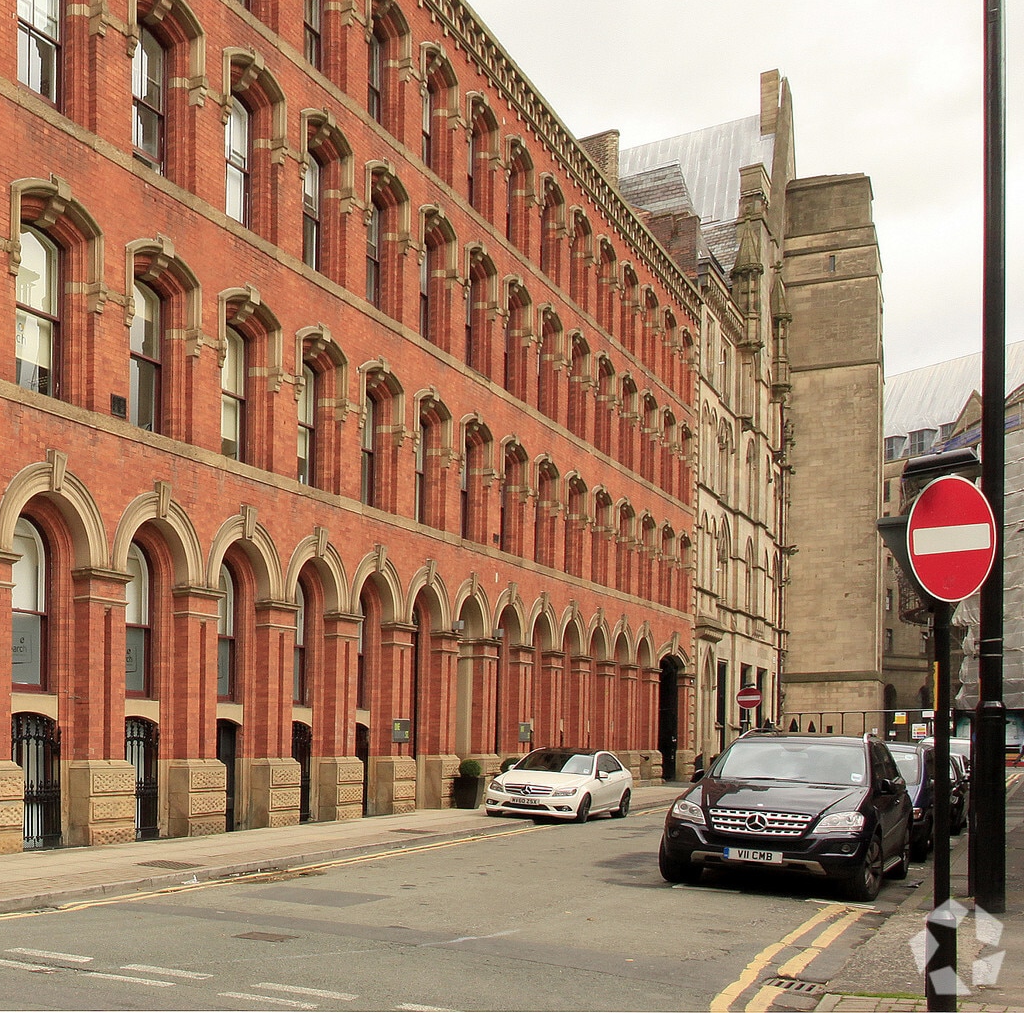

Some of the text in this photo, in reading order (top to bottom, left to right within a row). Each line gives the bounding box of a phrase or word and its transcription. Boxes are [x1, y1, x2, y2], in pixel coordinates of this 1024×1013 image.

[12, 645, 28, 653] arch
[737, 849, 773, 861] V11 CMB
